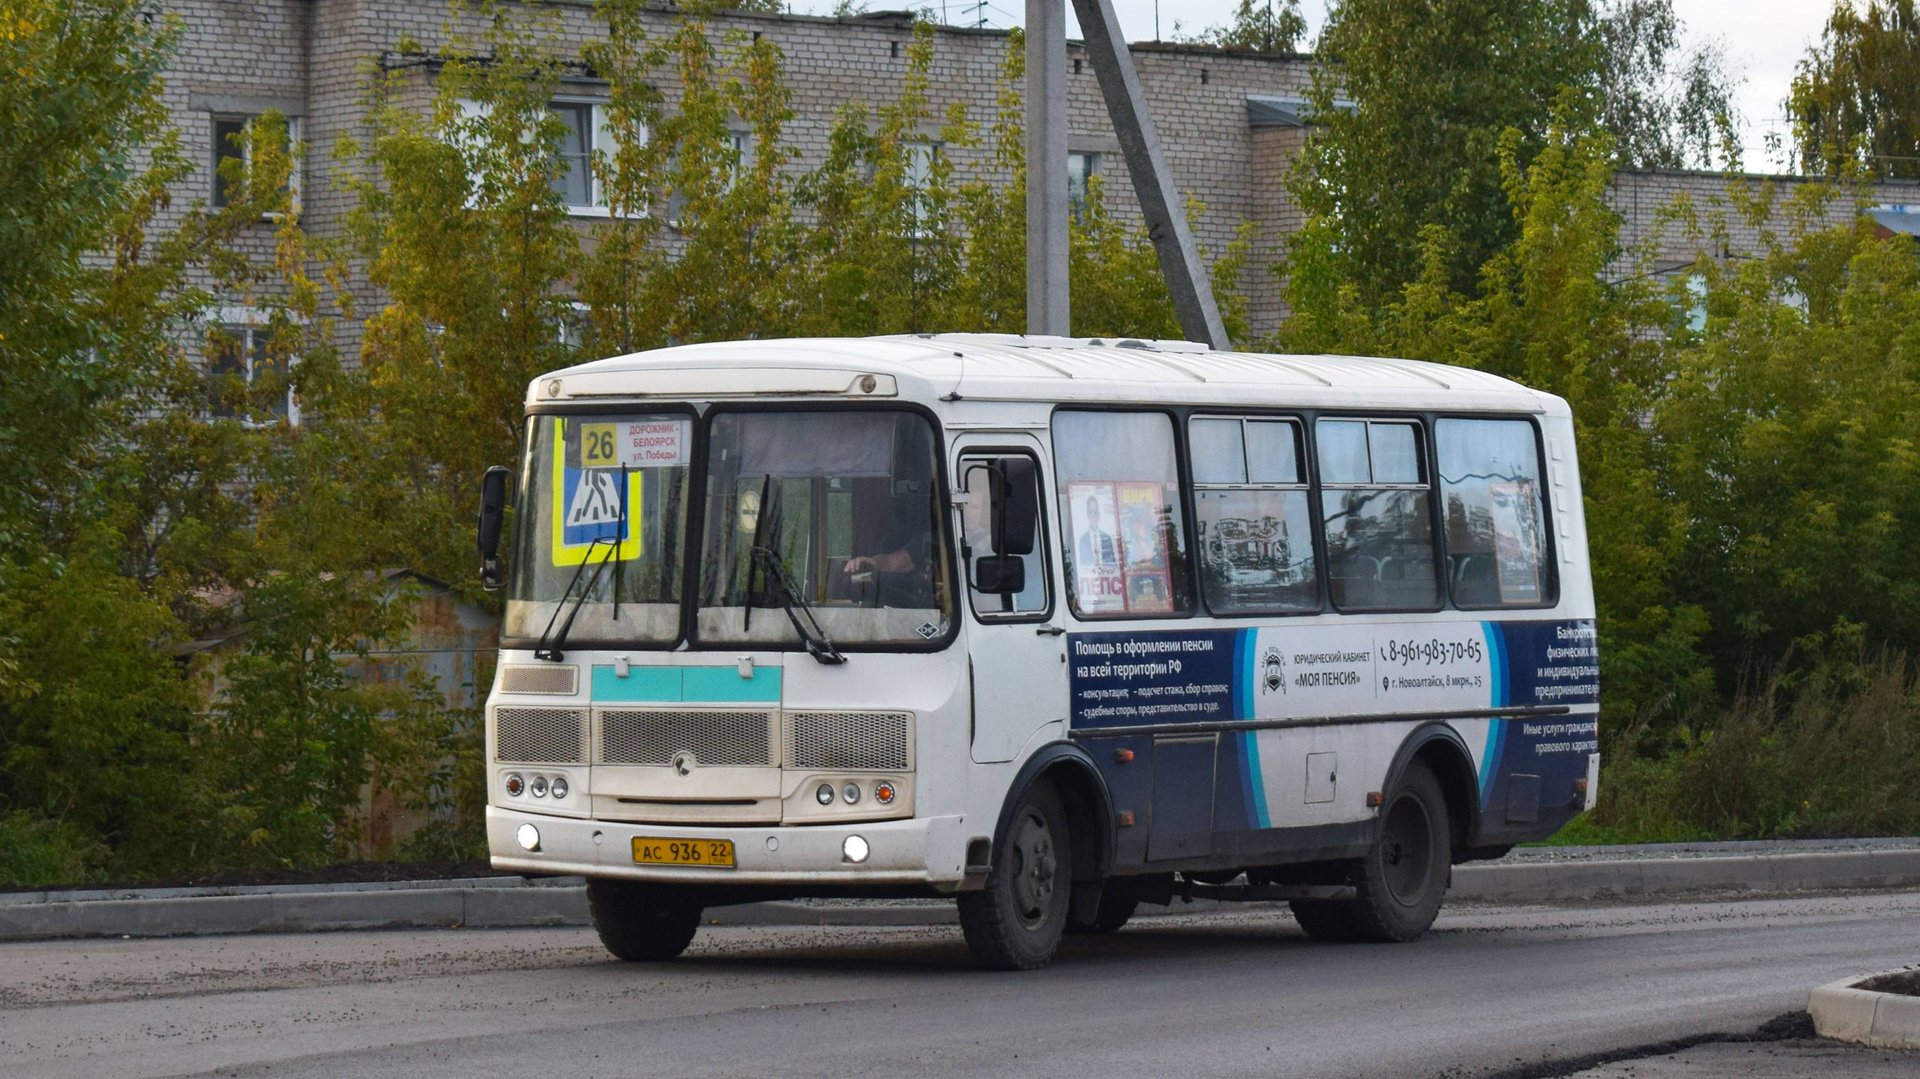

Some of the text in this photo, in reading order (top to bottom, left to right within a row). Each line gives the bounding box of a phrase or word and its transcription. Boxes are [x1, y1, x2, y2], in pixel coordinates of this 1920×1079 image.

[586, 431, 614, 459] 26
[630, 424, 674, 436] ДОРОЖНИК
[633, 437, 676, 448] БЕЛОЯРСК
[632, 449, 676, 462] ул. Победы
[1080, 576, 1122, 596] ЛЕПС
[1076, 638, 1214, 658] Помощь в оформлении пенсии
[1390, 638, 1482, 666] 8-961-983-70-65
[1546, 644, 1589, 662] физических
[1294, 651, 1342, 666] ЮРИДИЧЕСКИЙ
[1342, 652, 1370, 662] КАБИНЕТ
[1078, 659, 1182, 680] на всей территории РФ
[1537, 667, 1543, 678] и
[1295, 671, 1360, 687] «МОЯ ПЕНСИЯ»
[1392, 680, 1398, 688] г.
[1398, 674, 1444, 688] Новоалтайск,
[1446, 674, 1450, 686] 8
[1474, 676, 1482, 687] 25
[1138, 686, 1164, 698] подсчет
[1186, 683, 1200, 696] сбор
[1084, 705, 1114, 719] судебные
[1138, 702, 1198, 716] представительство
[1524, 723, 1542, 735] Иные
[1543, 724, 1564, 737] услуги
[1536, 742, 1570, 756] правового
[670, 843, 701, 861] 936
[710, 843, 728, 856] 22
